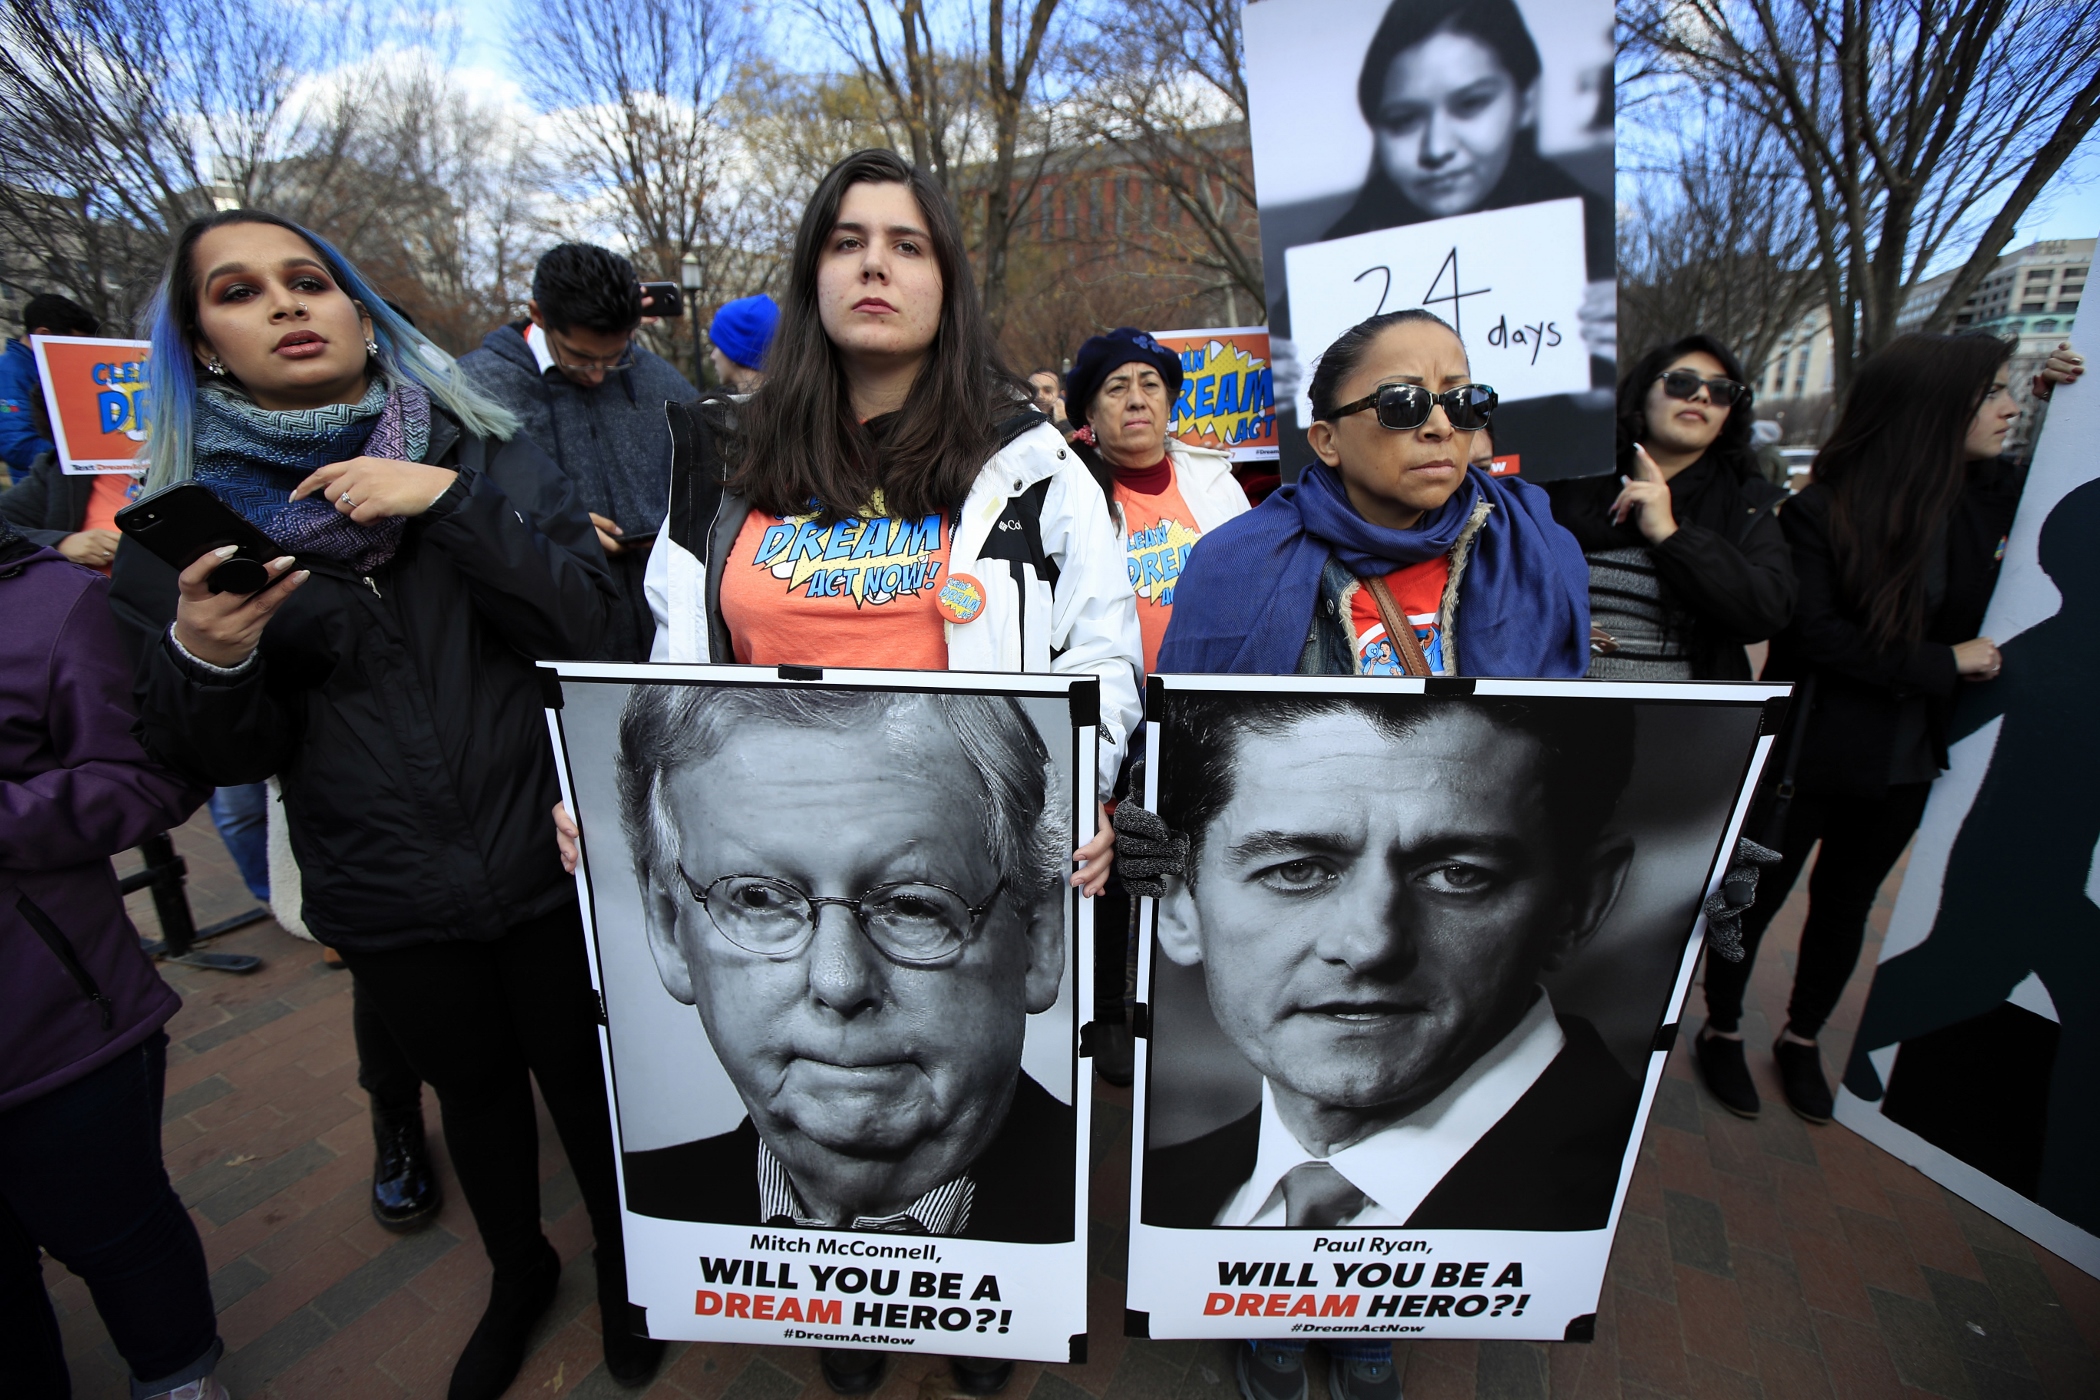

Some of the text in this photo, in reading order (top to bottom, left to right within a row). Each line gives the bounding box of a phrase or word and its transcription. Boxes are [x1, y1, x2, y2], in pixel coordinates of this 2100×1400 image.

[1487, 314, 1563, 367] days
[1181, 348, 1206, 373] AN
[1169, 368, 1275, 424] REAM
[1233, 413, 1276, 444] ACT
[752, 512, 943, 566] DREAM
[1127, 524, 1169, 553] LEAN
[806, 561, 943, 598] ACT NOW!
[1127, 542, 1193, 588] DREA
[938, 585, 982, 613] DREAM
[749, 1233, 943, 1263] Mitch McConnell,
[1312, 1237, 1434, 1256] Paul Ryan,
[699, 1256, 1003, 1303] WILL YOU BE A
[1217, 1262, 1524, 1289] WILL YOU BE A
[694, 1289, 1014, 1334] DREAM HERO?!
[1203, 1292, 1532, 1318] DREAM HERO?!
[783, 1328, 916, 1346] #DreamActNow
[1290, 1323, 1427, 1333] #DreamActNow
